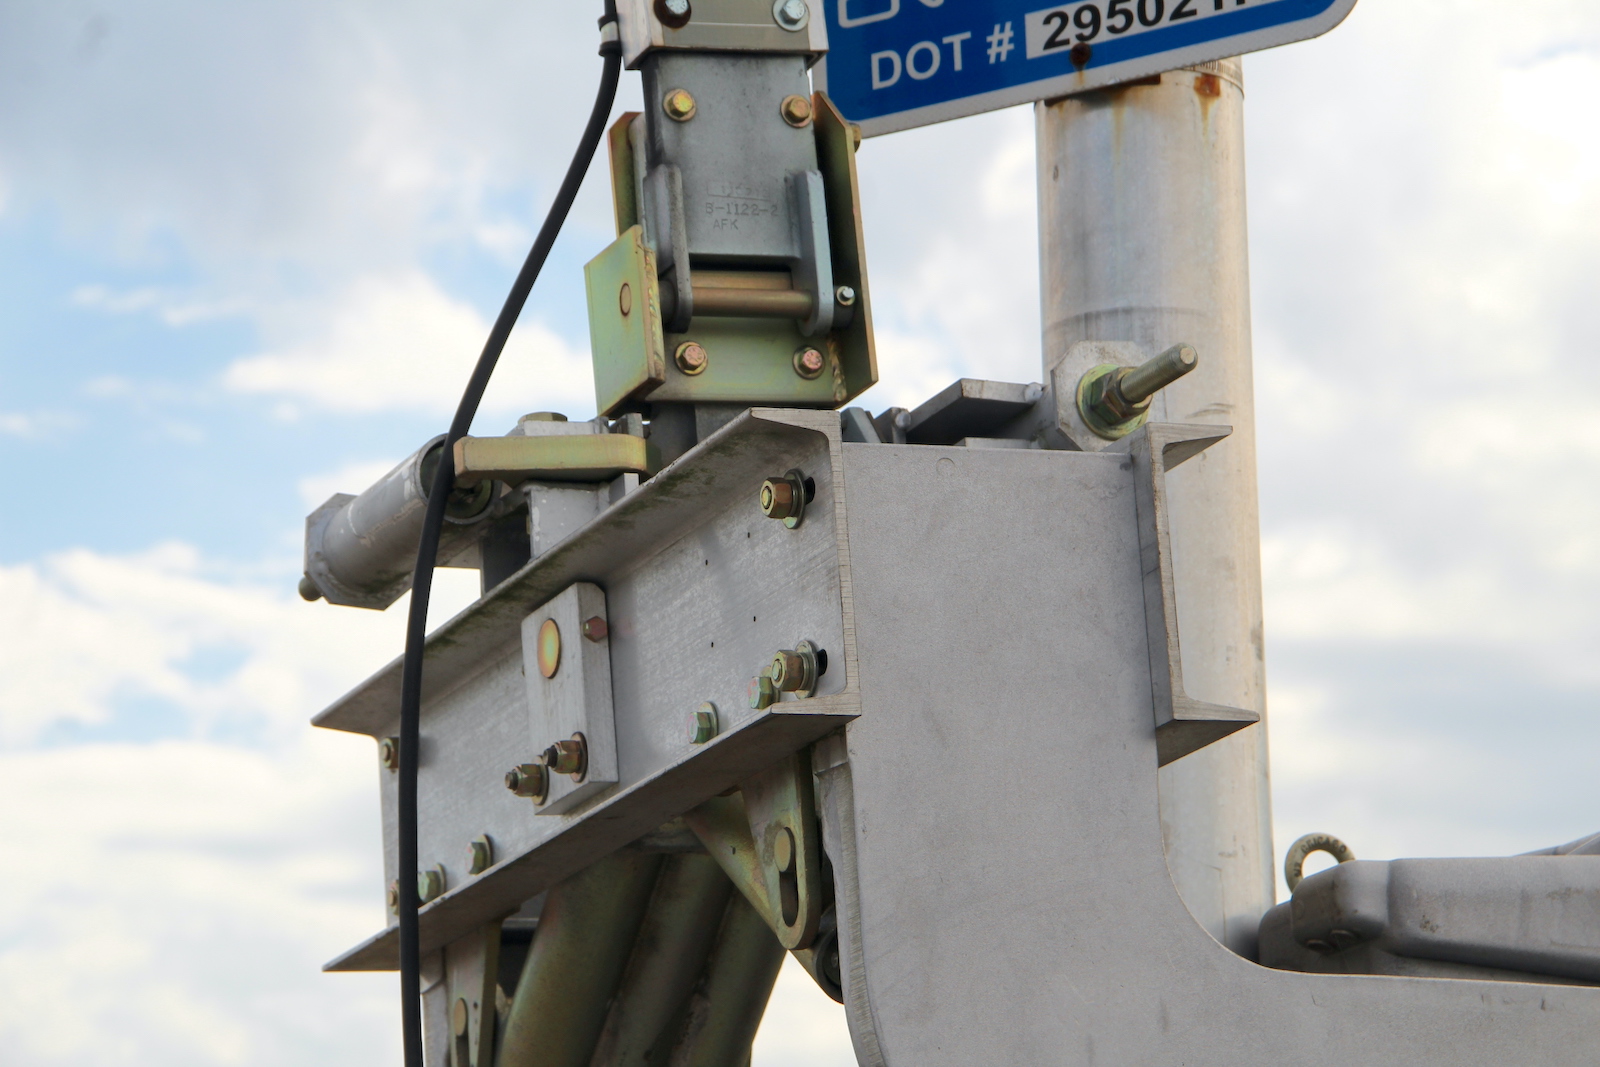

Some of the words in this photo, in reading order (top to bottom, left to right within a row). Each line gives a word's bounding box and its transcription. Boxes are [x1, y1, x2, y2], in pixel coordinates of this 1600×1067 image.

[871, 31, 971, 90] DOT
[986, 21, 1015, 64] #
[1042, 0, 1246, 50] 29502
[713, 218, 739, 231] AFK
